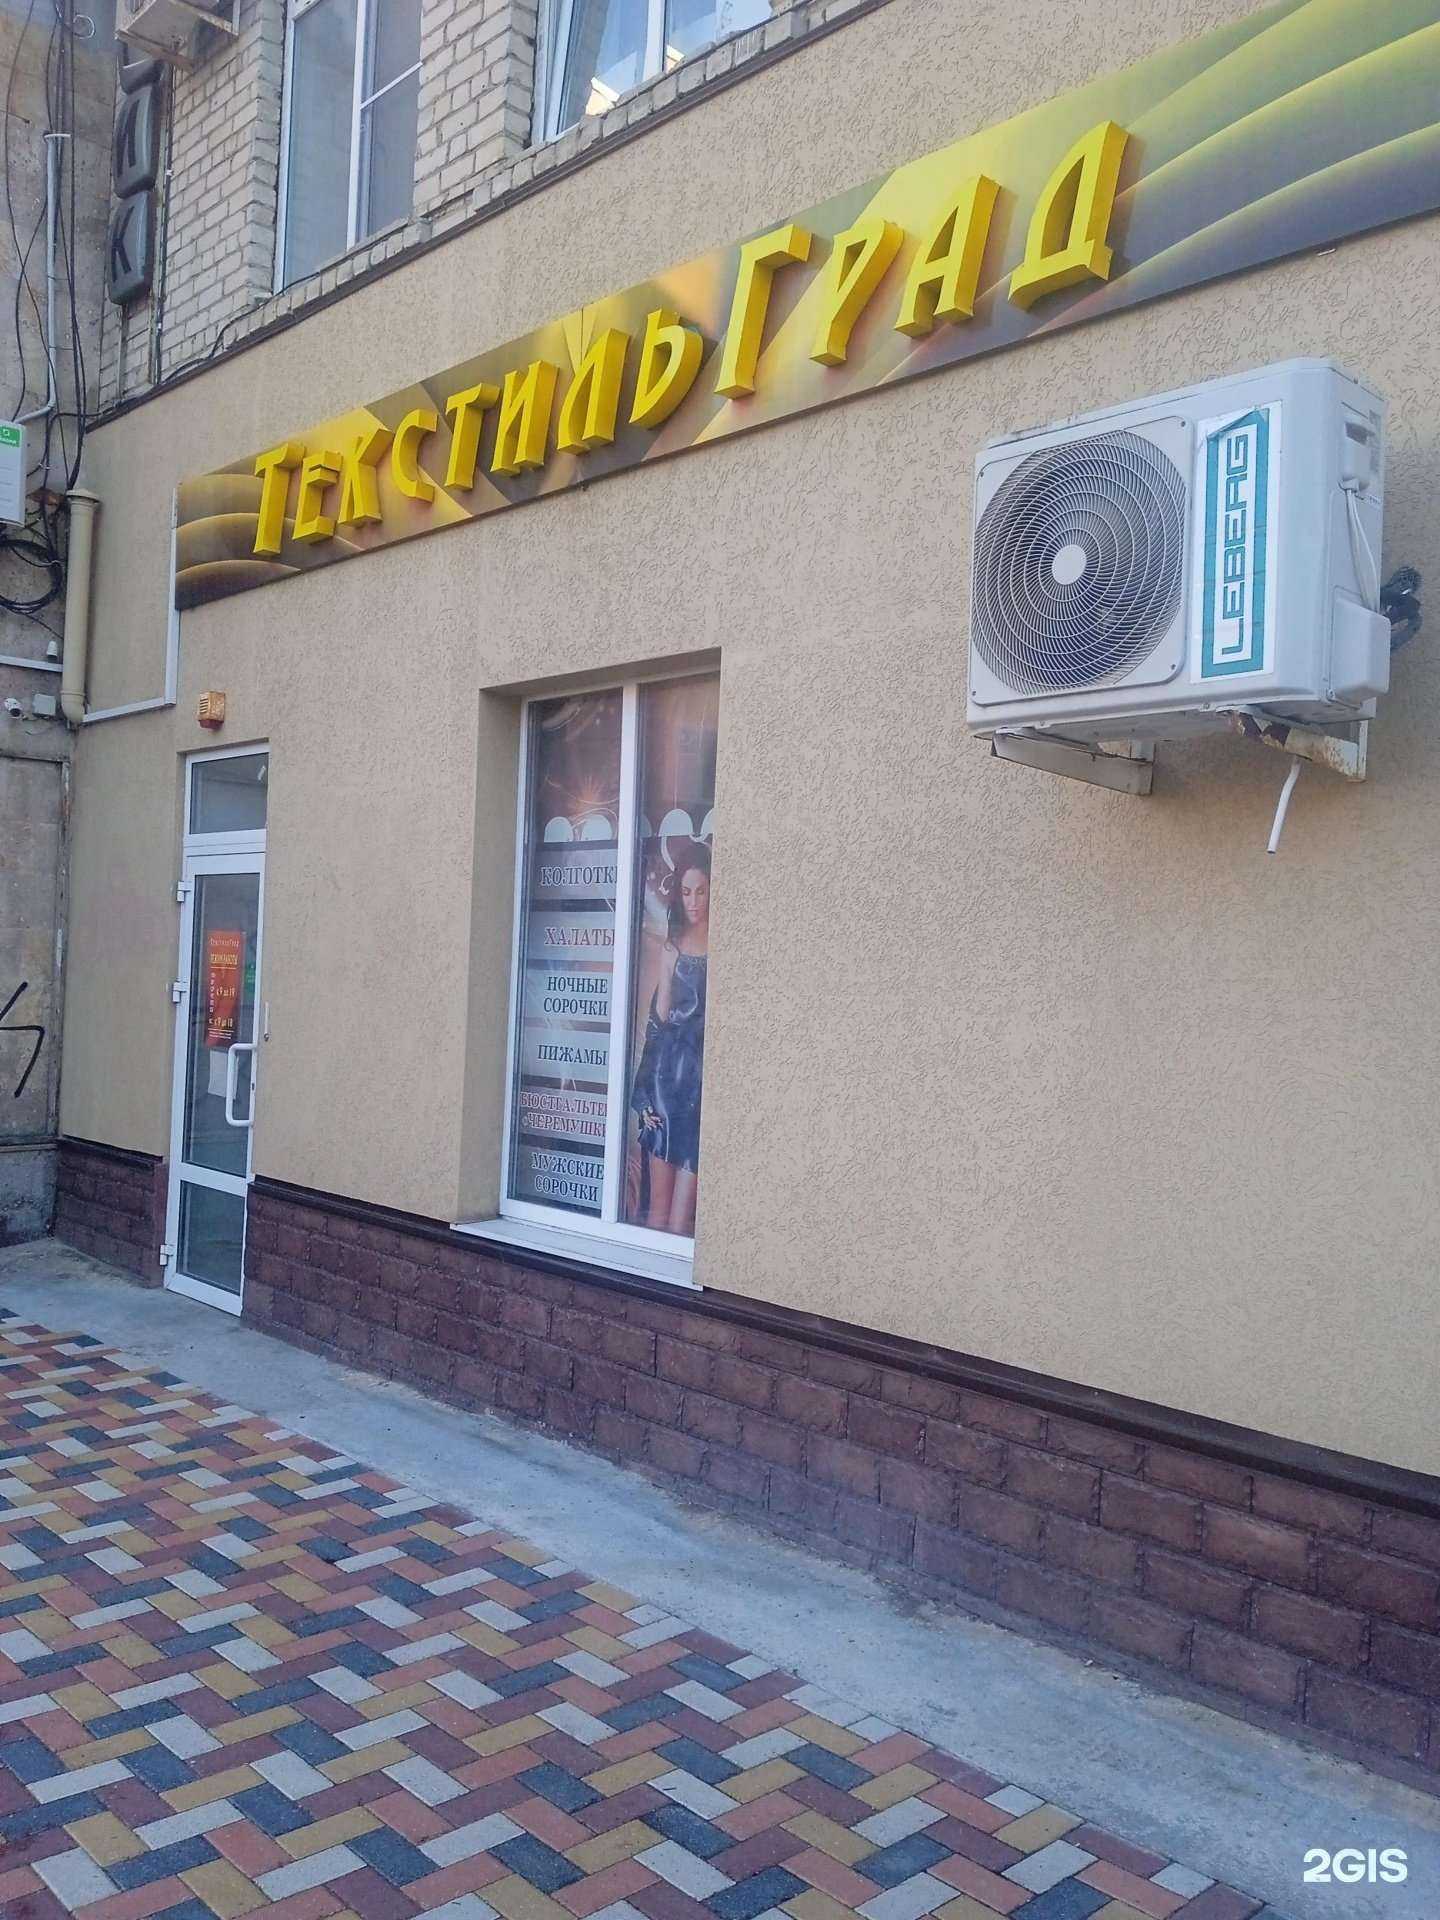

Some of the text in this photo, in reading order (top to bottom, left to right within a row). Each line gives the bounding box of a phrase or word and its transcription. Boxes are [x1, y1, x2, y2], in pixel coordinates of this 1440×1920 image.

[1221, 433, 1249, 655] LEBERG
[541, 866, 617, 885] КОЛГОТК
[545, 927, 615, 946] ХАЛАТЫ
[547, 976, 608, 993] НОЧНЫЕ
[543, 997, 608, 1016] СОРОЧКИ
[538, 1044, 607, 1066] ПИЖАМЫ
[520, 1091, 607, 1117] БЮСТГАЛЬТЕ
[532, 1152, 605, 1180] МУЖСКИЕ
[535, 1175, 599, 1202] СОРОЧКИ
